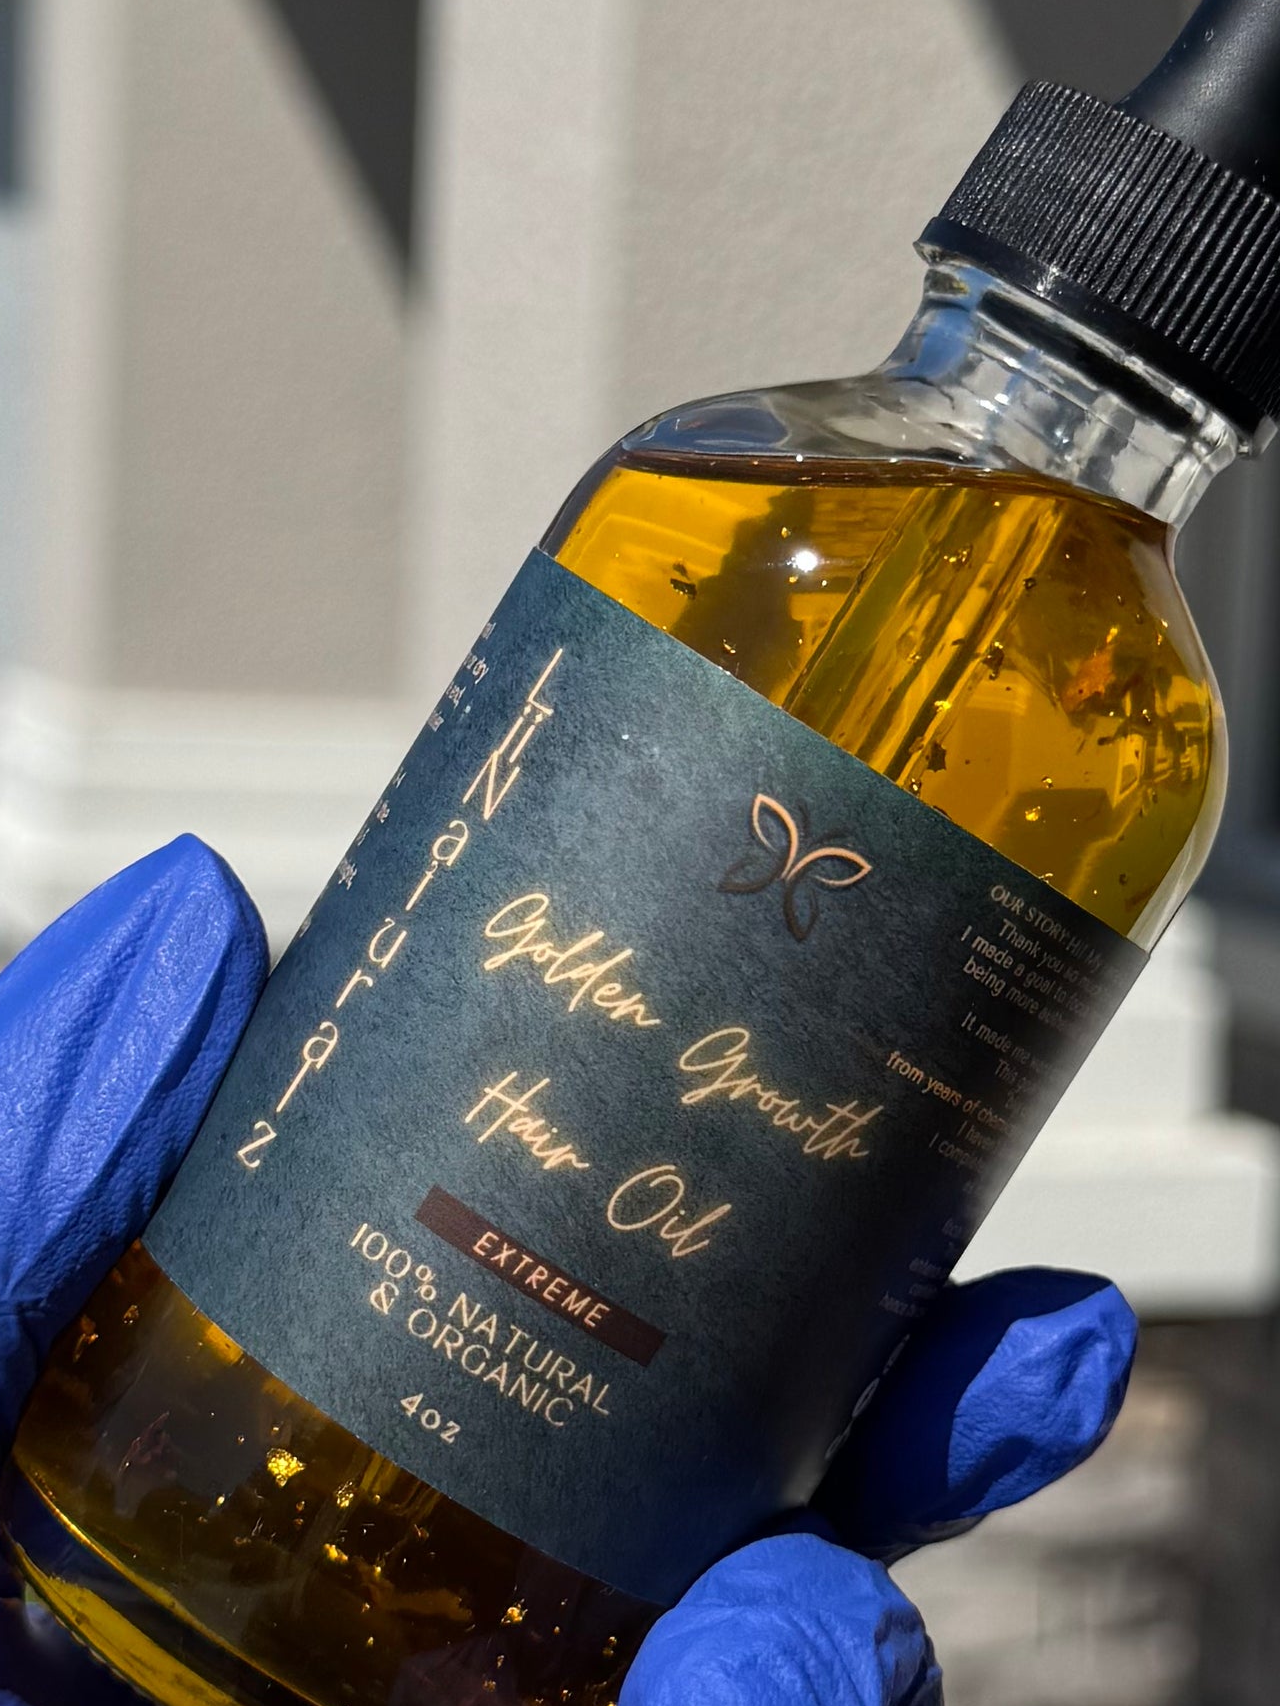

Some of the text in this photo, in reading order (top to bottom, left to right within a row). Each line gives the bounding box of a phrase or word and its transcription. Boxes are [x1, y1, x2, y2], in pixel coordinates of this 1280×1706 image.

[990, 884, 1025, 916] OUR
[960, 925, 972, 942] I
[972, 935, 1014, 969] made
[963, 955, 1007, 997] being
[998, 918, 1042, 958] Thank
[1036, 950, 1066, 975] you
[484, 893, 885, 1160] Golden Growth
[960, 1011, 977, 1032] It
[975, 1023, 1014, 1053] made
[886, 1050, 925, 1085] from
[922, 1076, 963, 1107] years
[962, 1099, 981, 1114] of
[464, 1071, 732, 1258] Hair Oil
[472, 1230, 611, 1329] EXTREME
[349, 1222, 610, 1416] 100% NATURAL
[369, 1281, 574, 1427] & ORGANIC
[399, 1393, 462, 1444] 4oz
